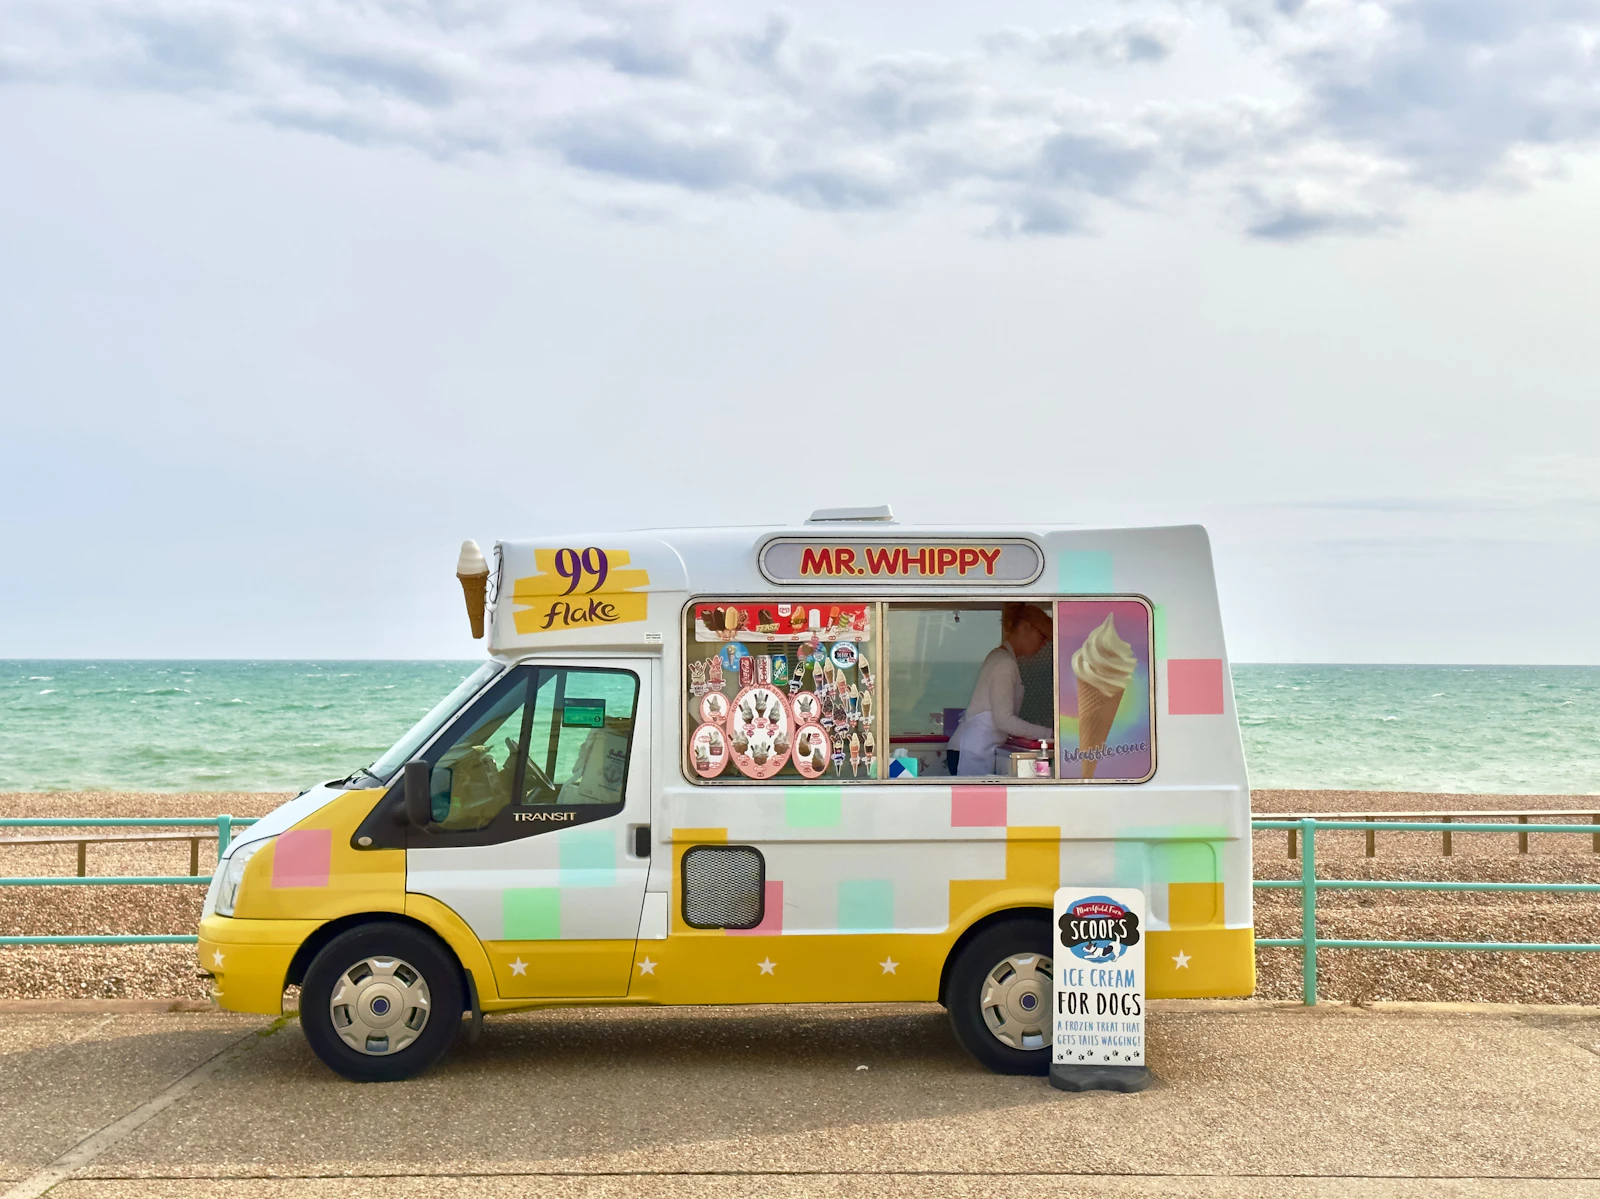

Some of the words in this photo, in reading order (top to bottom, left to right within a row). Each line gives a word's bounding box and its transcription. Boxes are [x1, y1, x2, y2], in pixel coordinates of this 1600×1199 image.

[554, 546, 609, 597] 99
[539, 597, 621, 629] flake
[1115, 741, 1148, 756] cone
[513, 812, 577, 821] TRANSIT
[1070, 918, 1128, 940] SCOOP'S
[1063, 968, 1085, 987] ICE
[1090, 969, 1135, 988] CREAM
[1058, 991, 1090, 1015] FOR
[1096, 992, 1141, 1016] DOGS
[1057, 1021, 1063, 1031] A
[1065, 1021, 1094, 1032] FROZEN
[1096, 1022, 1119, 1033] TREAT
[1121, 1022, 1140, 1033] THAT
[1057, 1035, 1076, 1046] GETS
[1078, 1035, 1099, 1046] TAILS
[1101, 1036, 1141, 1047] WAGGING!
